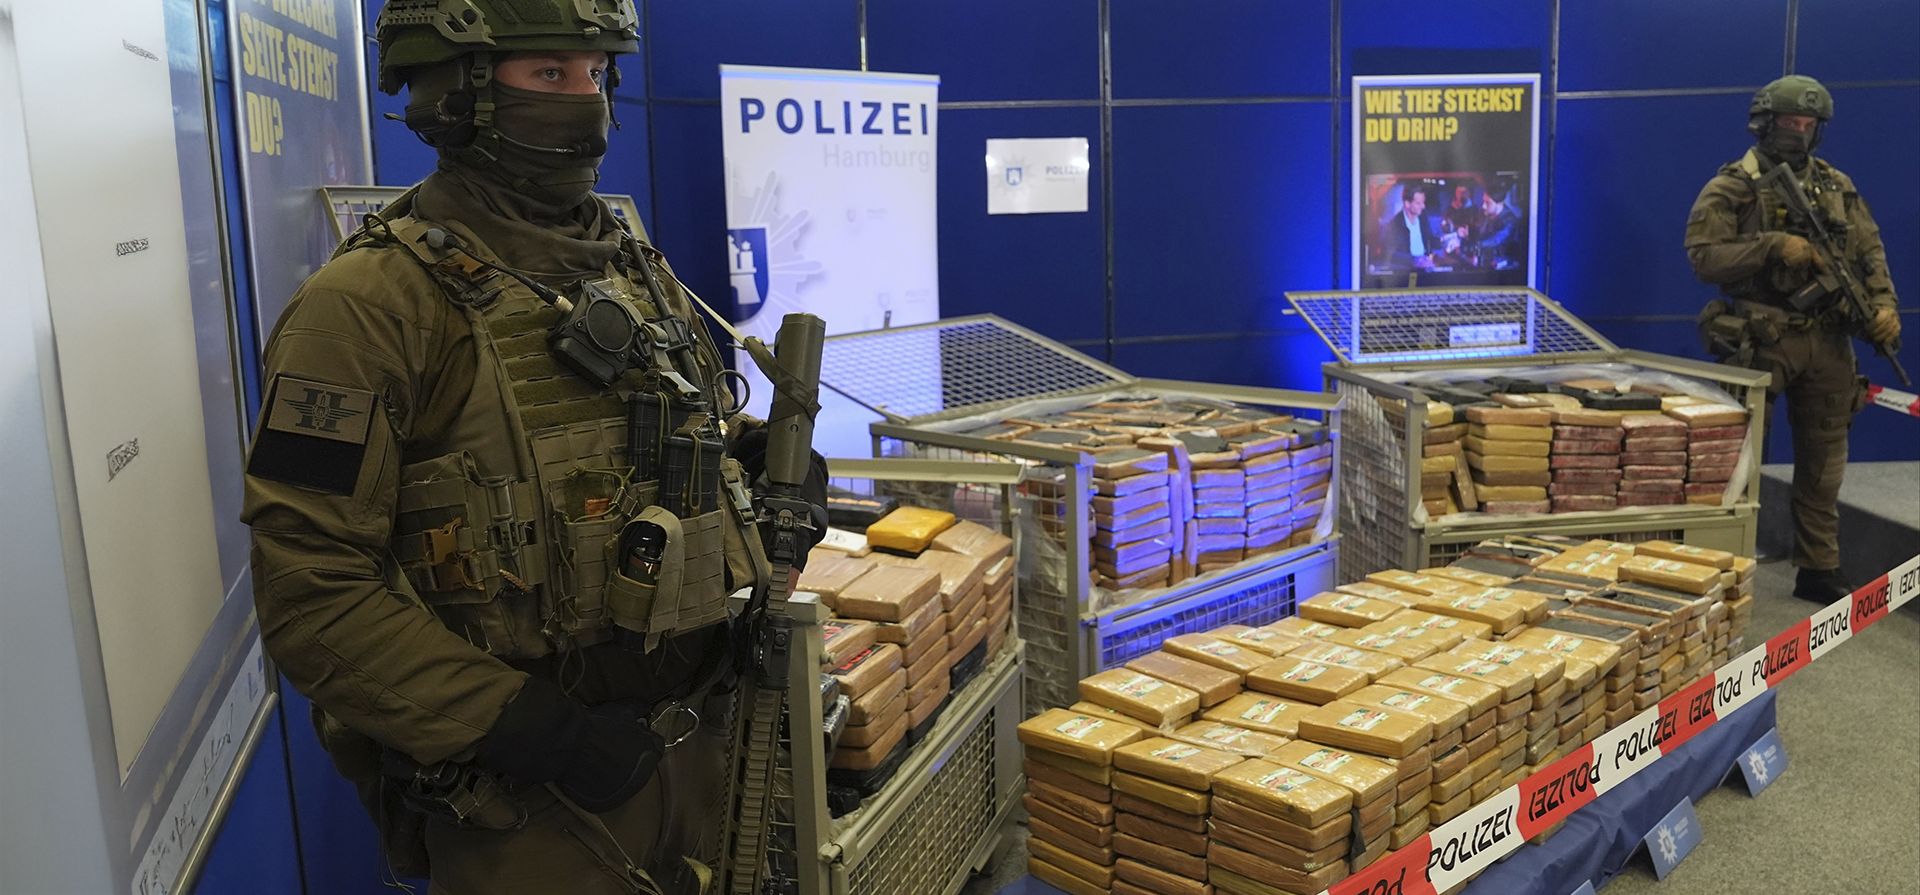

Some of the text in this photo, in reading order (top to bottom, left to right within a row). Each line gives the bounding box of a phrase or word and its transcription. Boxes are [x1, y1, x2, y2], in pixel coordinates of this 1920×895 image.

[240, 12, 338, 102] SEITE STEHST
[246, 91, 284, 156] DU?
[740, 98, 929, 135] POLIZEI
[1365, 88, 1524, 114] WIE TIEF STECKST
[1365, 117, 1458, 143] DU DRIN?
[823, 143, 930, 172] Hamburg
[1856, 581, 1893, 622] POLIZEI
[1808, 608, 1849, 652] POLIZEI
[1752, 637, 1799, 686] POLIZEI
[1689, 671, 1742, 725] POLIZEI
[1615, 708, 1678, 769] POLIZEI
[1529, 754, 1603, 821] POLIZEI
[1425, 805, 1513, 882] POLIZEI
